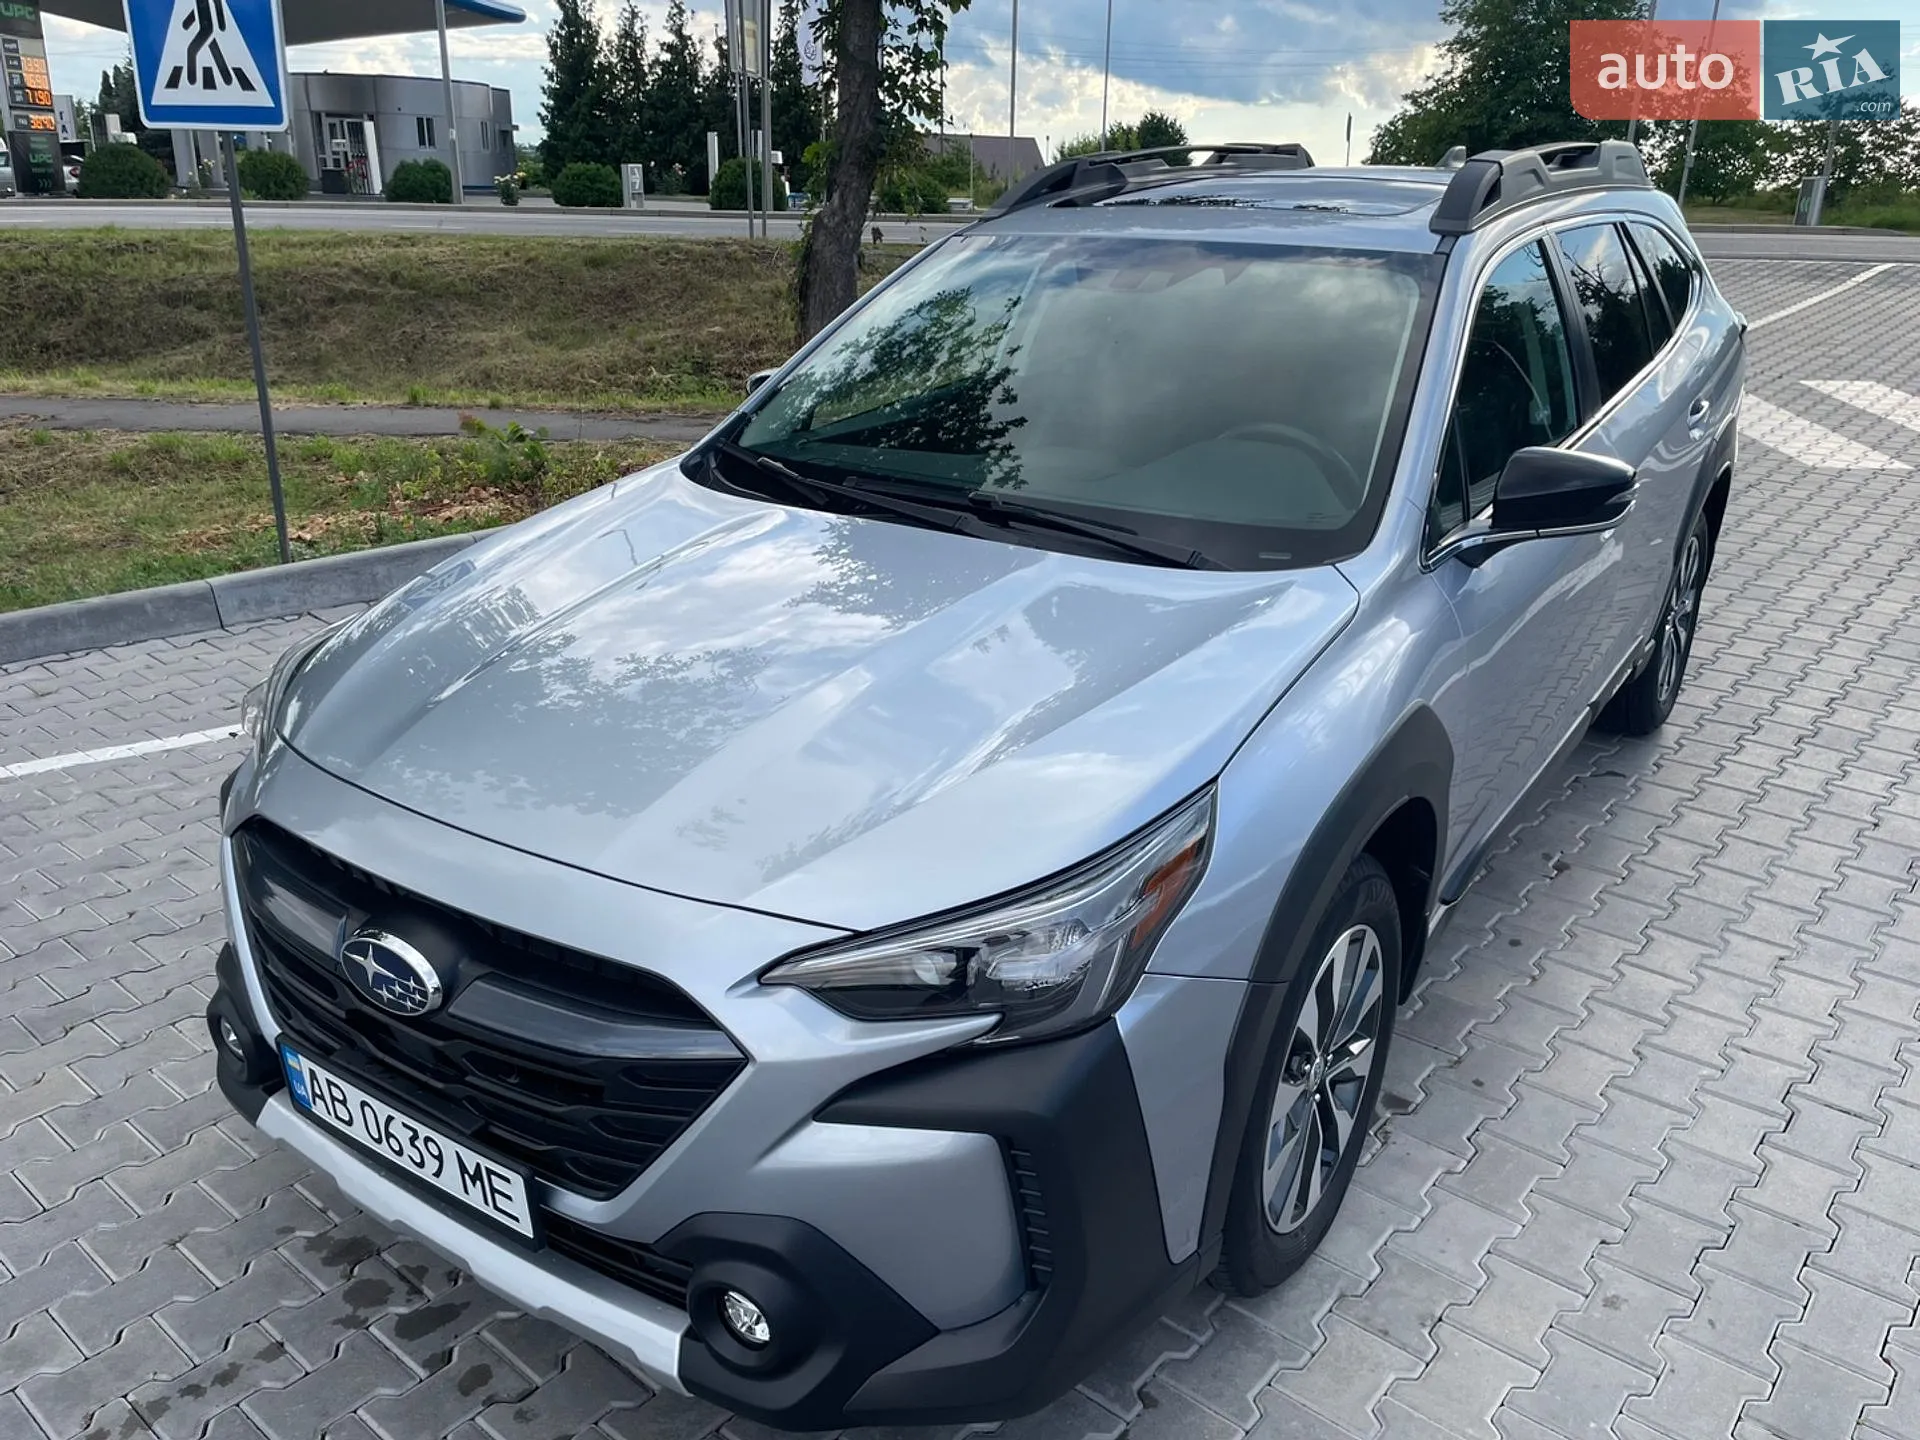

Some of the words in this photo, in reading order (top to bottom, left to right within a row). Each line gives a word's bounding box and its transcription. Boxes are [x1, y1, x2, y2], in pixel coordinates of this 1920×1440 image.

[293, 1080, 308, 1100] UA
[308, 1068, 354, 1127] AB
[360, 1100, 445, 1178] 0639
[455, 1150, 520, 1223] ME
